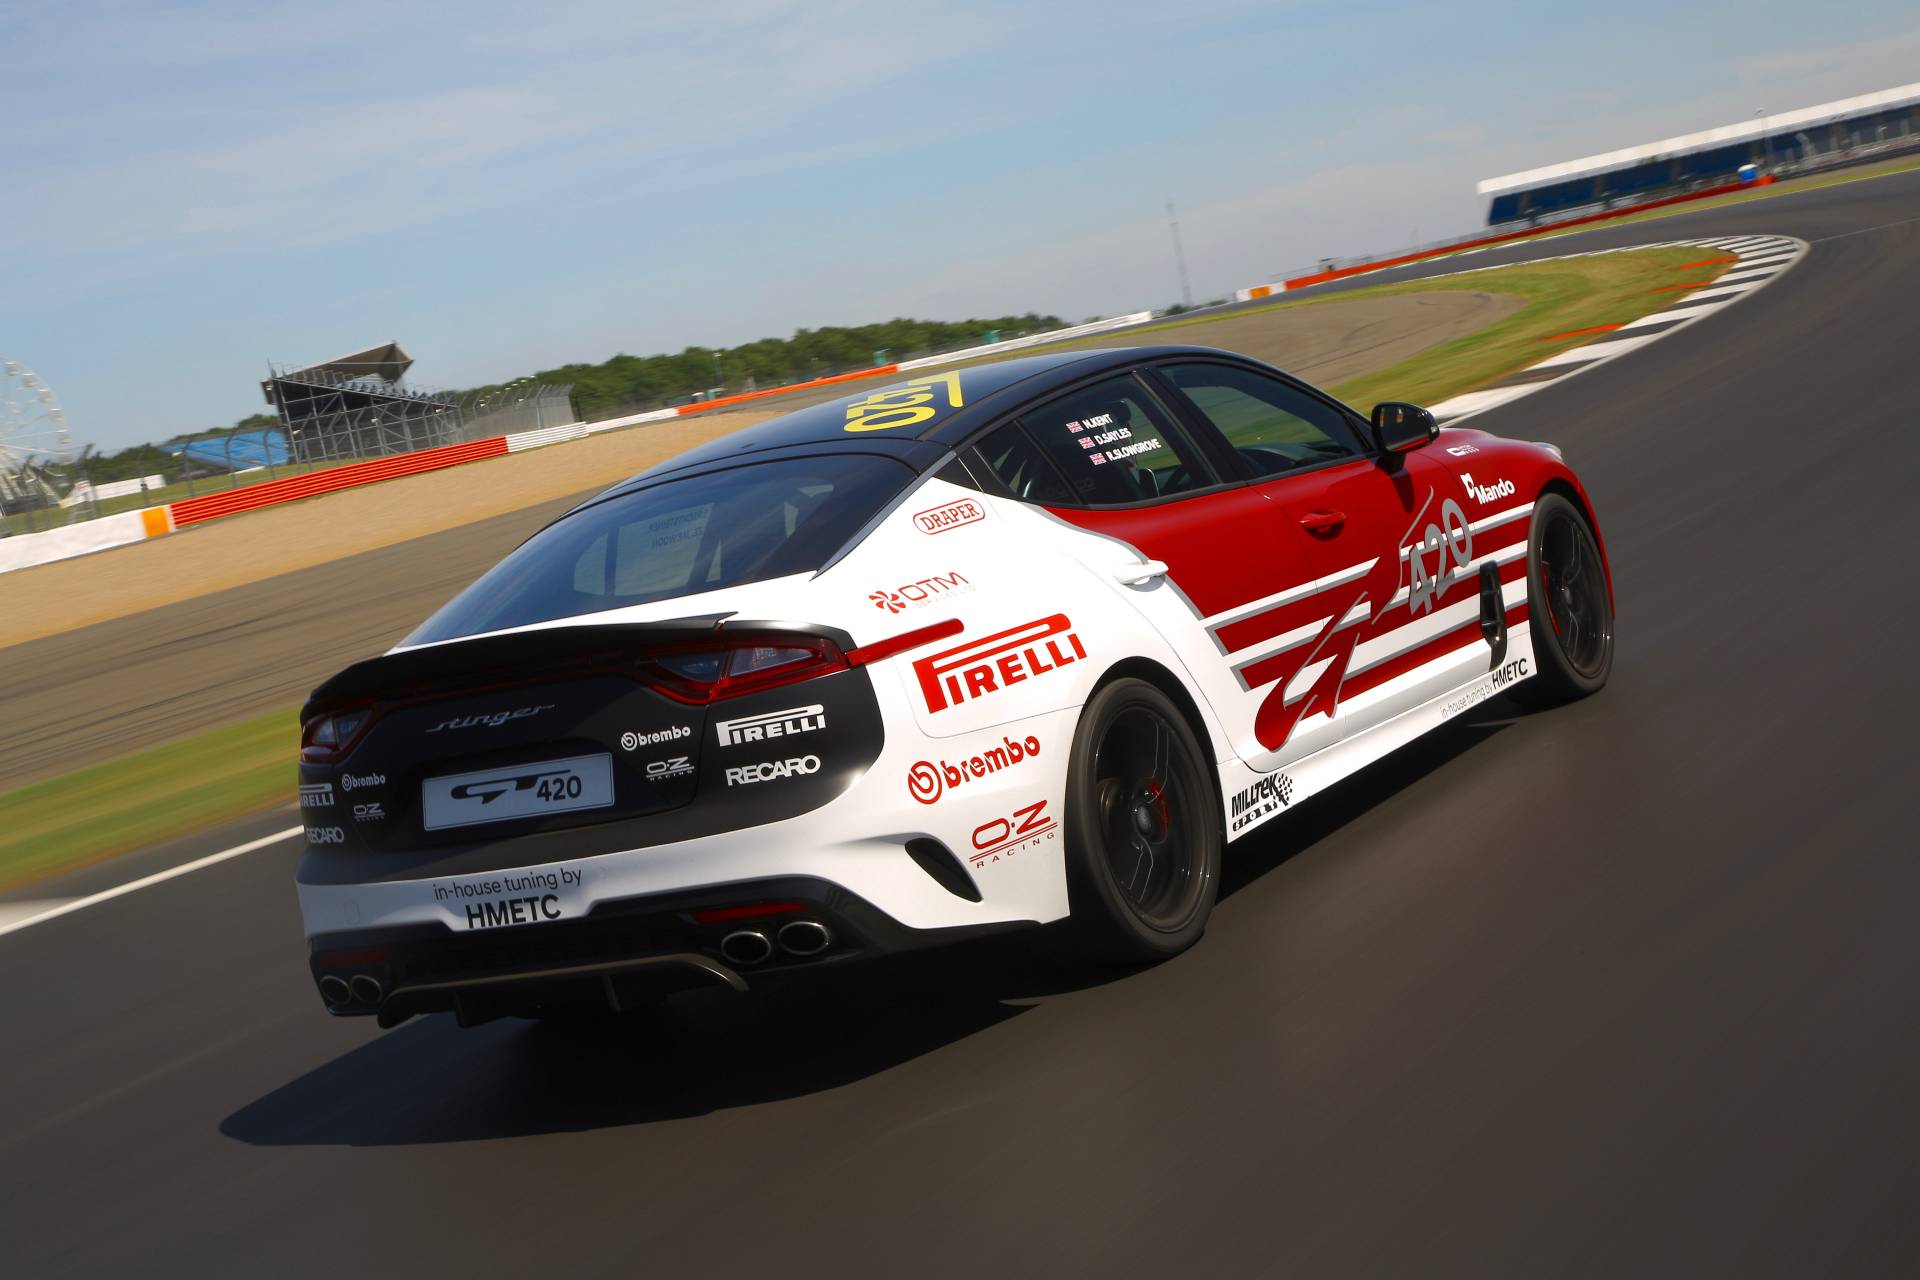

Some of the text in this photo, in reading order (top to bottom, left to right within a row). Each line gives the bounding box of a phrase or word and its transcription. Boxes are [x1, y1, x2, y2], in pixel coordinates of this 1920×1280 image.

[1082, 413, 1113, 430] N.KENT
[1094, 427, 1133, 446] D.SAYLES
[1105, 438, 1162, 462] R.SLOWGROVE
[1474, 478, 1516, 505] Mando
[920, 502, 980, 531] DRAPER
[1410, 498, 1473, 615] 420
[898, 572, 970, 601] OTM
[912, 613, 1088, 714] PIRELLI
[1491, 657, 1528, 690] HMETC
[637, 725, 691, 747] brembo
[716, 703, 827, 748] PIRELLI
[725, 754, 821, 787] RECARO
[940, 735, 1041, 789] brembo
[351, 772, 387, 788] brembo
[536, 775, 582, 803] 420
[1234, 800, 1275, 831] SPORT
[975, 832, 1056, 869] RACING
[432, 867, 582, 901] in-house tuning by
[465, 893, 562, 929] HMETC
